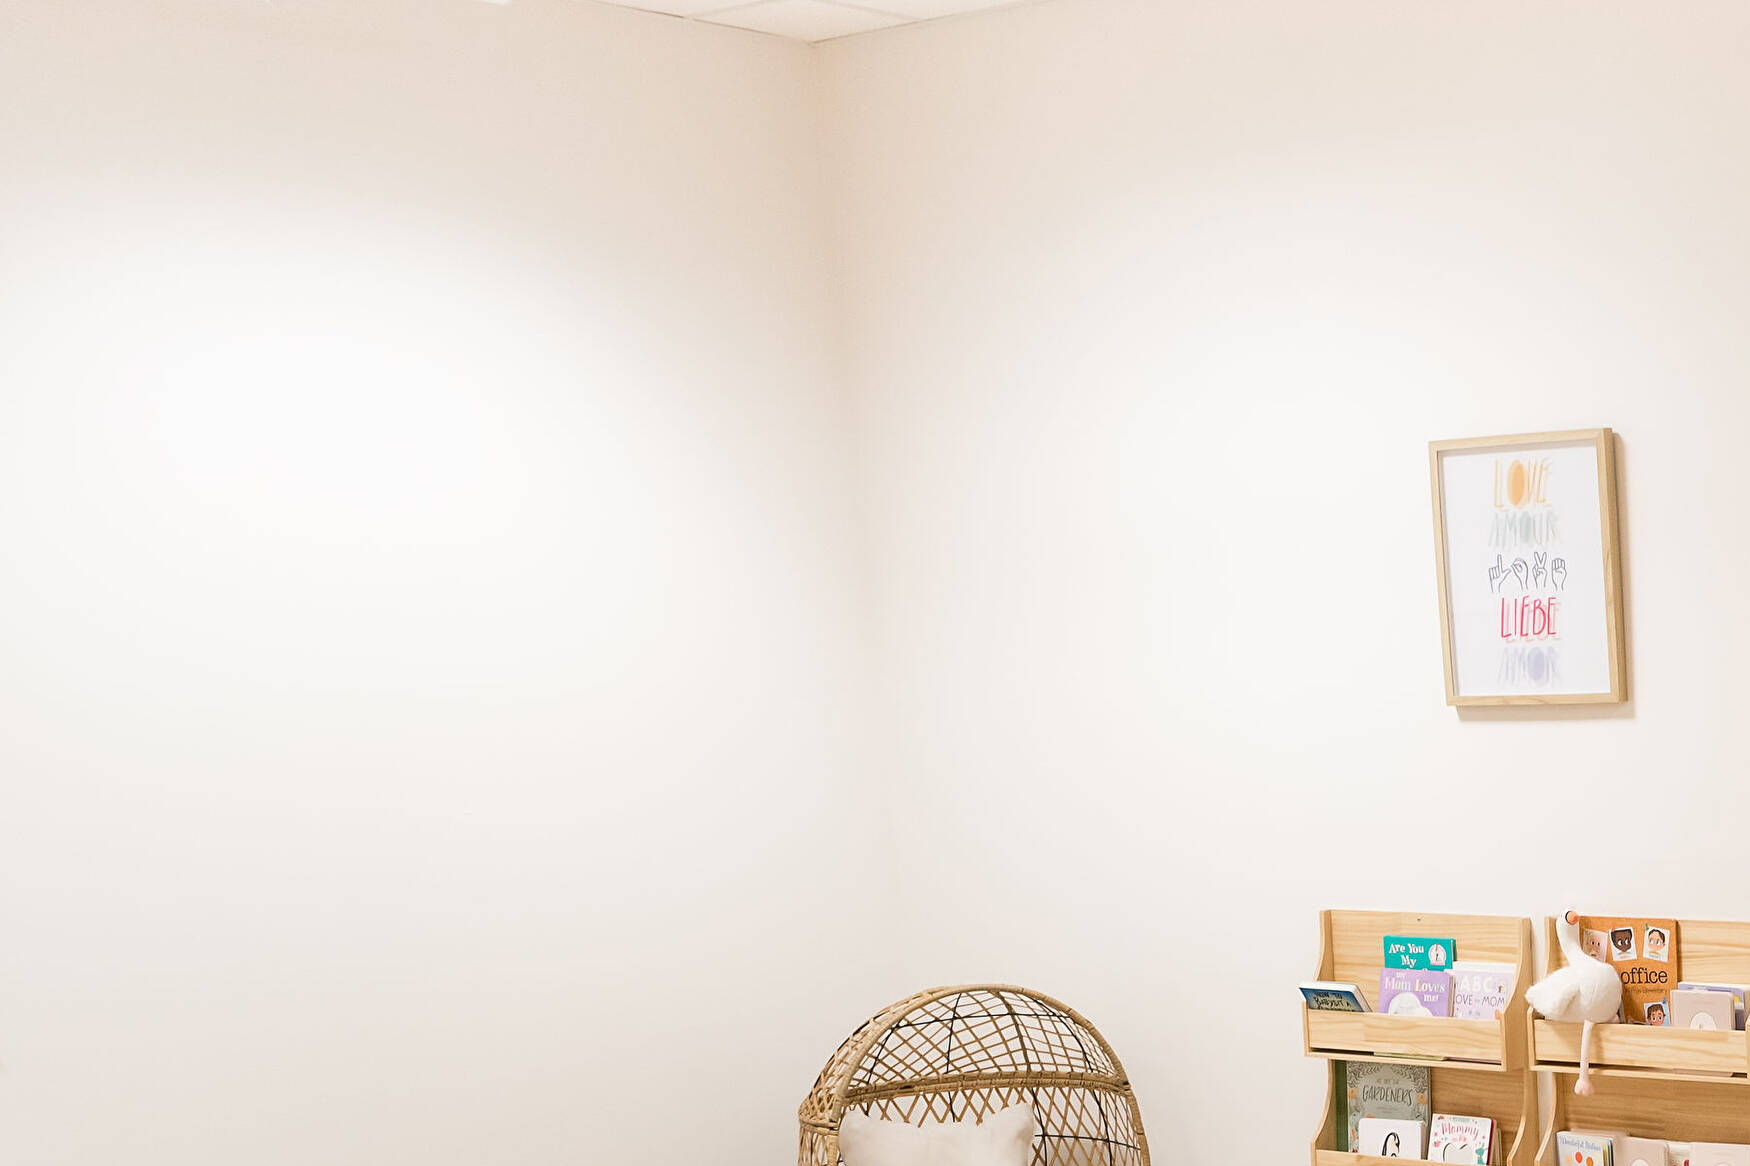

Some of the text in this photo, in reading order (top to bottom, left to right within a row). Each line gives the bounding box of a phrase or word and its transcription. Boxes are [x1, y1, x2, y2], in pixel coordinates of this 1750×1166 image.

[1501, 595, 1560, 641] LIEBE
[1389, 943, 1424, 953] Are You
[1401, 955, 1416, 968] My
[1620, 967, 1668, 984] office
[1384, 977, 1445, 992] Mom Loves
[1455, 994, 1473, 1005] OVE
[1362, 1085, 1413, 1106] GARDENERS
